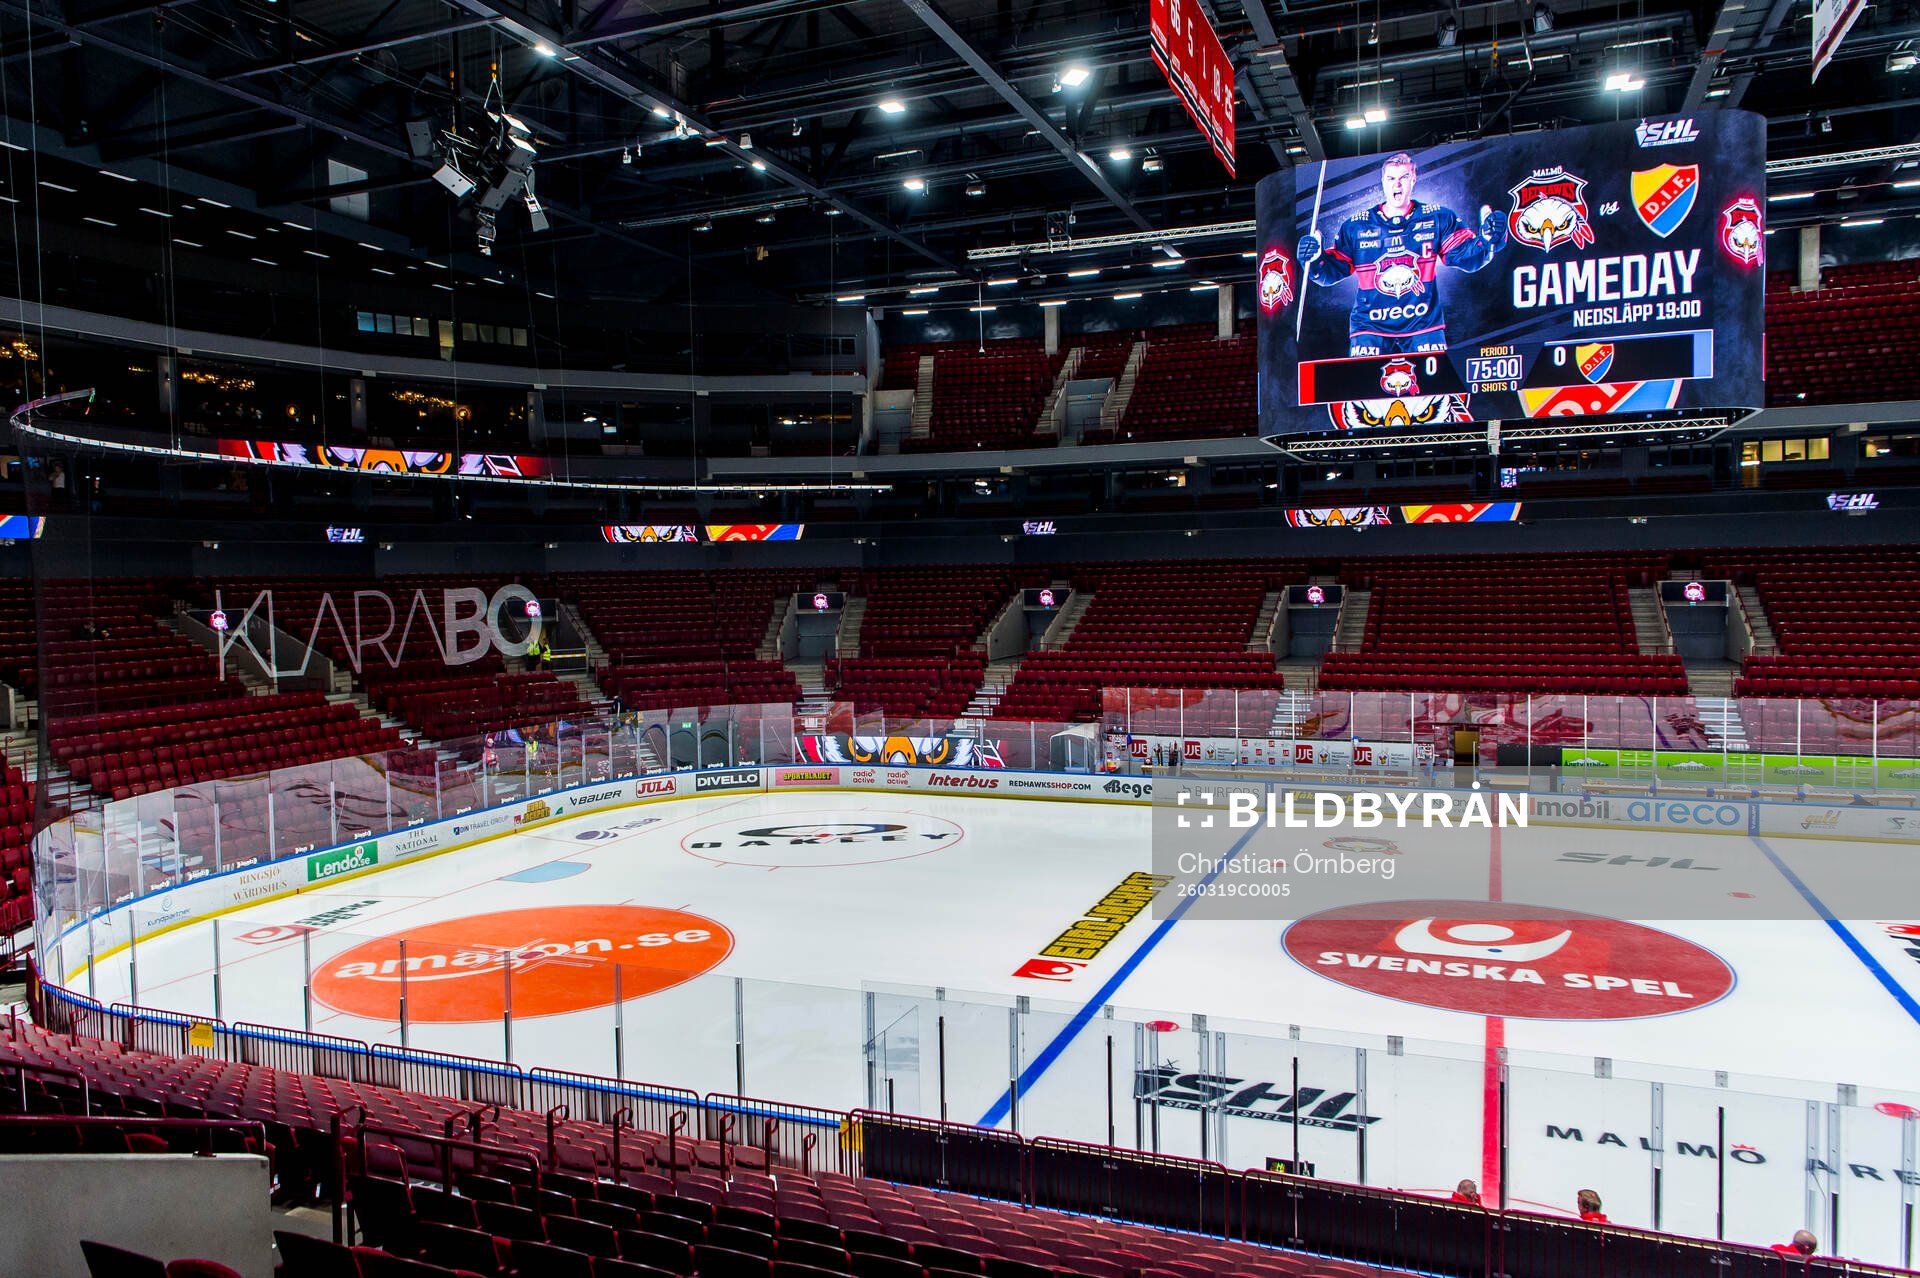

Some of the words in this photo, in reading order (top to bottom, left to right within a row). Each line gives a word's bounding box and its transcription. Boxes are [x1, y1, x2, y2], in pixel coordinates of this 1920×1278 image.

[1644, 118, 1700, 142] SHL
[1532, 164, 1563, 178] MALMÖ
[1644, 173, 1692, 216] D.I.F.
[1422, 241, 1433, 259] C
[1513, 248, 1702, 309] GAMEDAY
[1369, 302, 1429, 321] areco
[1573, 303, 1654, 328] NEDSLÄPP
[1656, 299, 1702, 321] 19:00
[1351, 345, 1380, 357] MAXI
[1480, 345, 1508, 357] PERIOD
[1509, 345, 1514, 355] 1
[1553, 346, 1566, 367] 0
[1425, 356, 1438, 376] 0
[1471, 358, 1519, 380] 75:00
[1471, 383, 1479, 394] 0
[1481, 381, 1508, 393] SHOTS
[1510, 380, 1518, 392] 0
[1835, 493, 1880, 506] SHL
[333, 527, 365, 540] SHL
[1028, 521, 1057, 532] SHL
[215, 583, 542, 682] KLARABO
[637, 780, 675, 795] JULA
[697, 773, 758, 787] DIVELLO
[853, 776, 876, 784] active
[886, 777, 909, 785] active
[928, 773, 1000, 789] Interbus
[1008, 780, 1092, 791] REDHAWKSSHOP.COM
[578, 789, 622, 806] BAUER
[1626, 799, 1741, 827] areco
[395, 834, 439, 852] NATIONAL
[408, 829, 426, 839] THE
[690, 833, 951, 849] OAKLEY
[315, 851, 371, 878] Lendo.se
[1554, 852, 1721, 871] SHL
[239, 867, 281, 886] RINGSJÖ
[232, 880, 289, 902] WÄRDSHUS
[335, 928, 712, 980] amazon.se
[1316, 951, 1546, 985] SVENSKA
[1562, 972, 1695, 999] SPEL
[1158, 1073, 1383, 1125] SHL
[1545, 1124, 1767, 1165] MALMÖ
